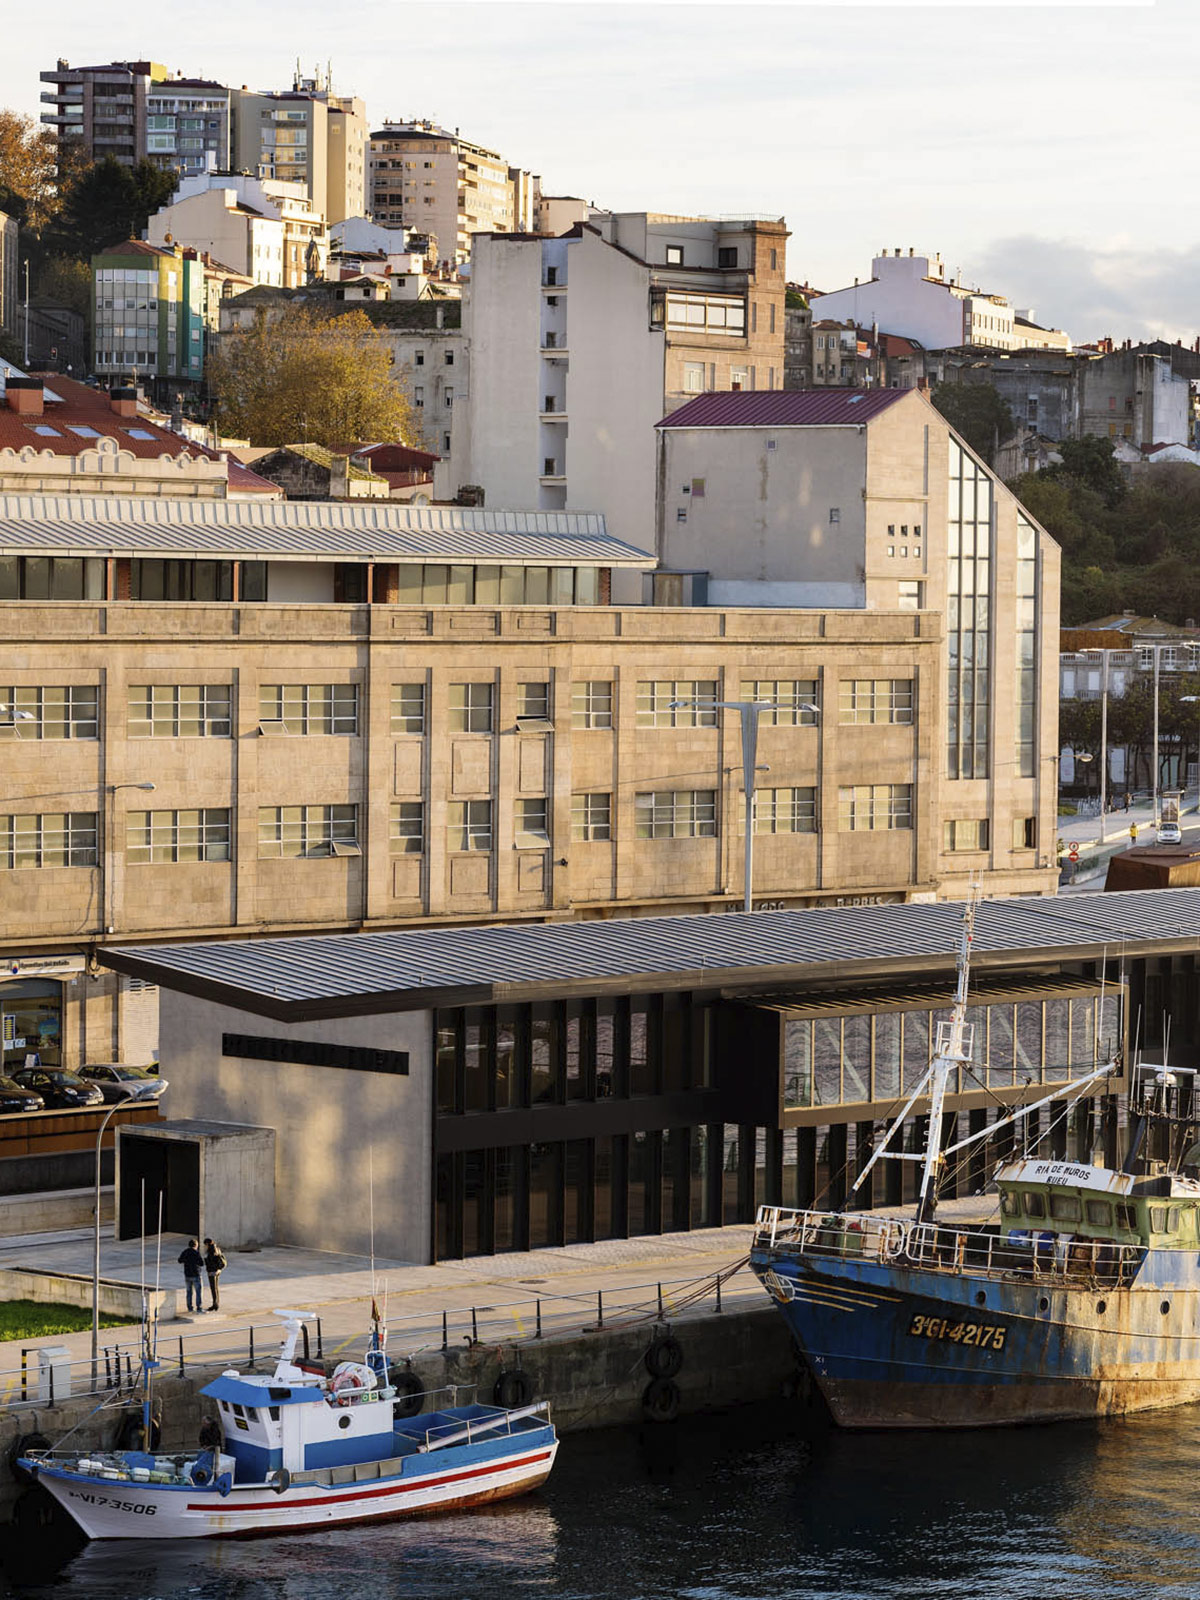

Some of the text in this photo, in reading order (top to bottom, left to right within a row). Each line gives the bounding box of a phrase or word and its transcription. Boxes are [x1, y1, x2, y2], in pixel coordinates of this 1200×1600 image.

[1035, 1165, 1091, 1181] RIA DE MUROS
